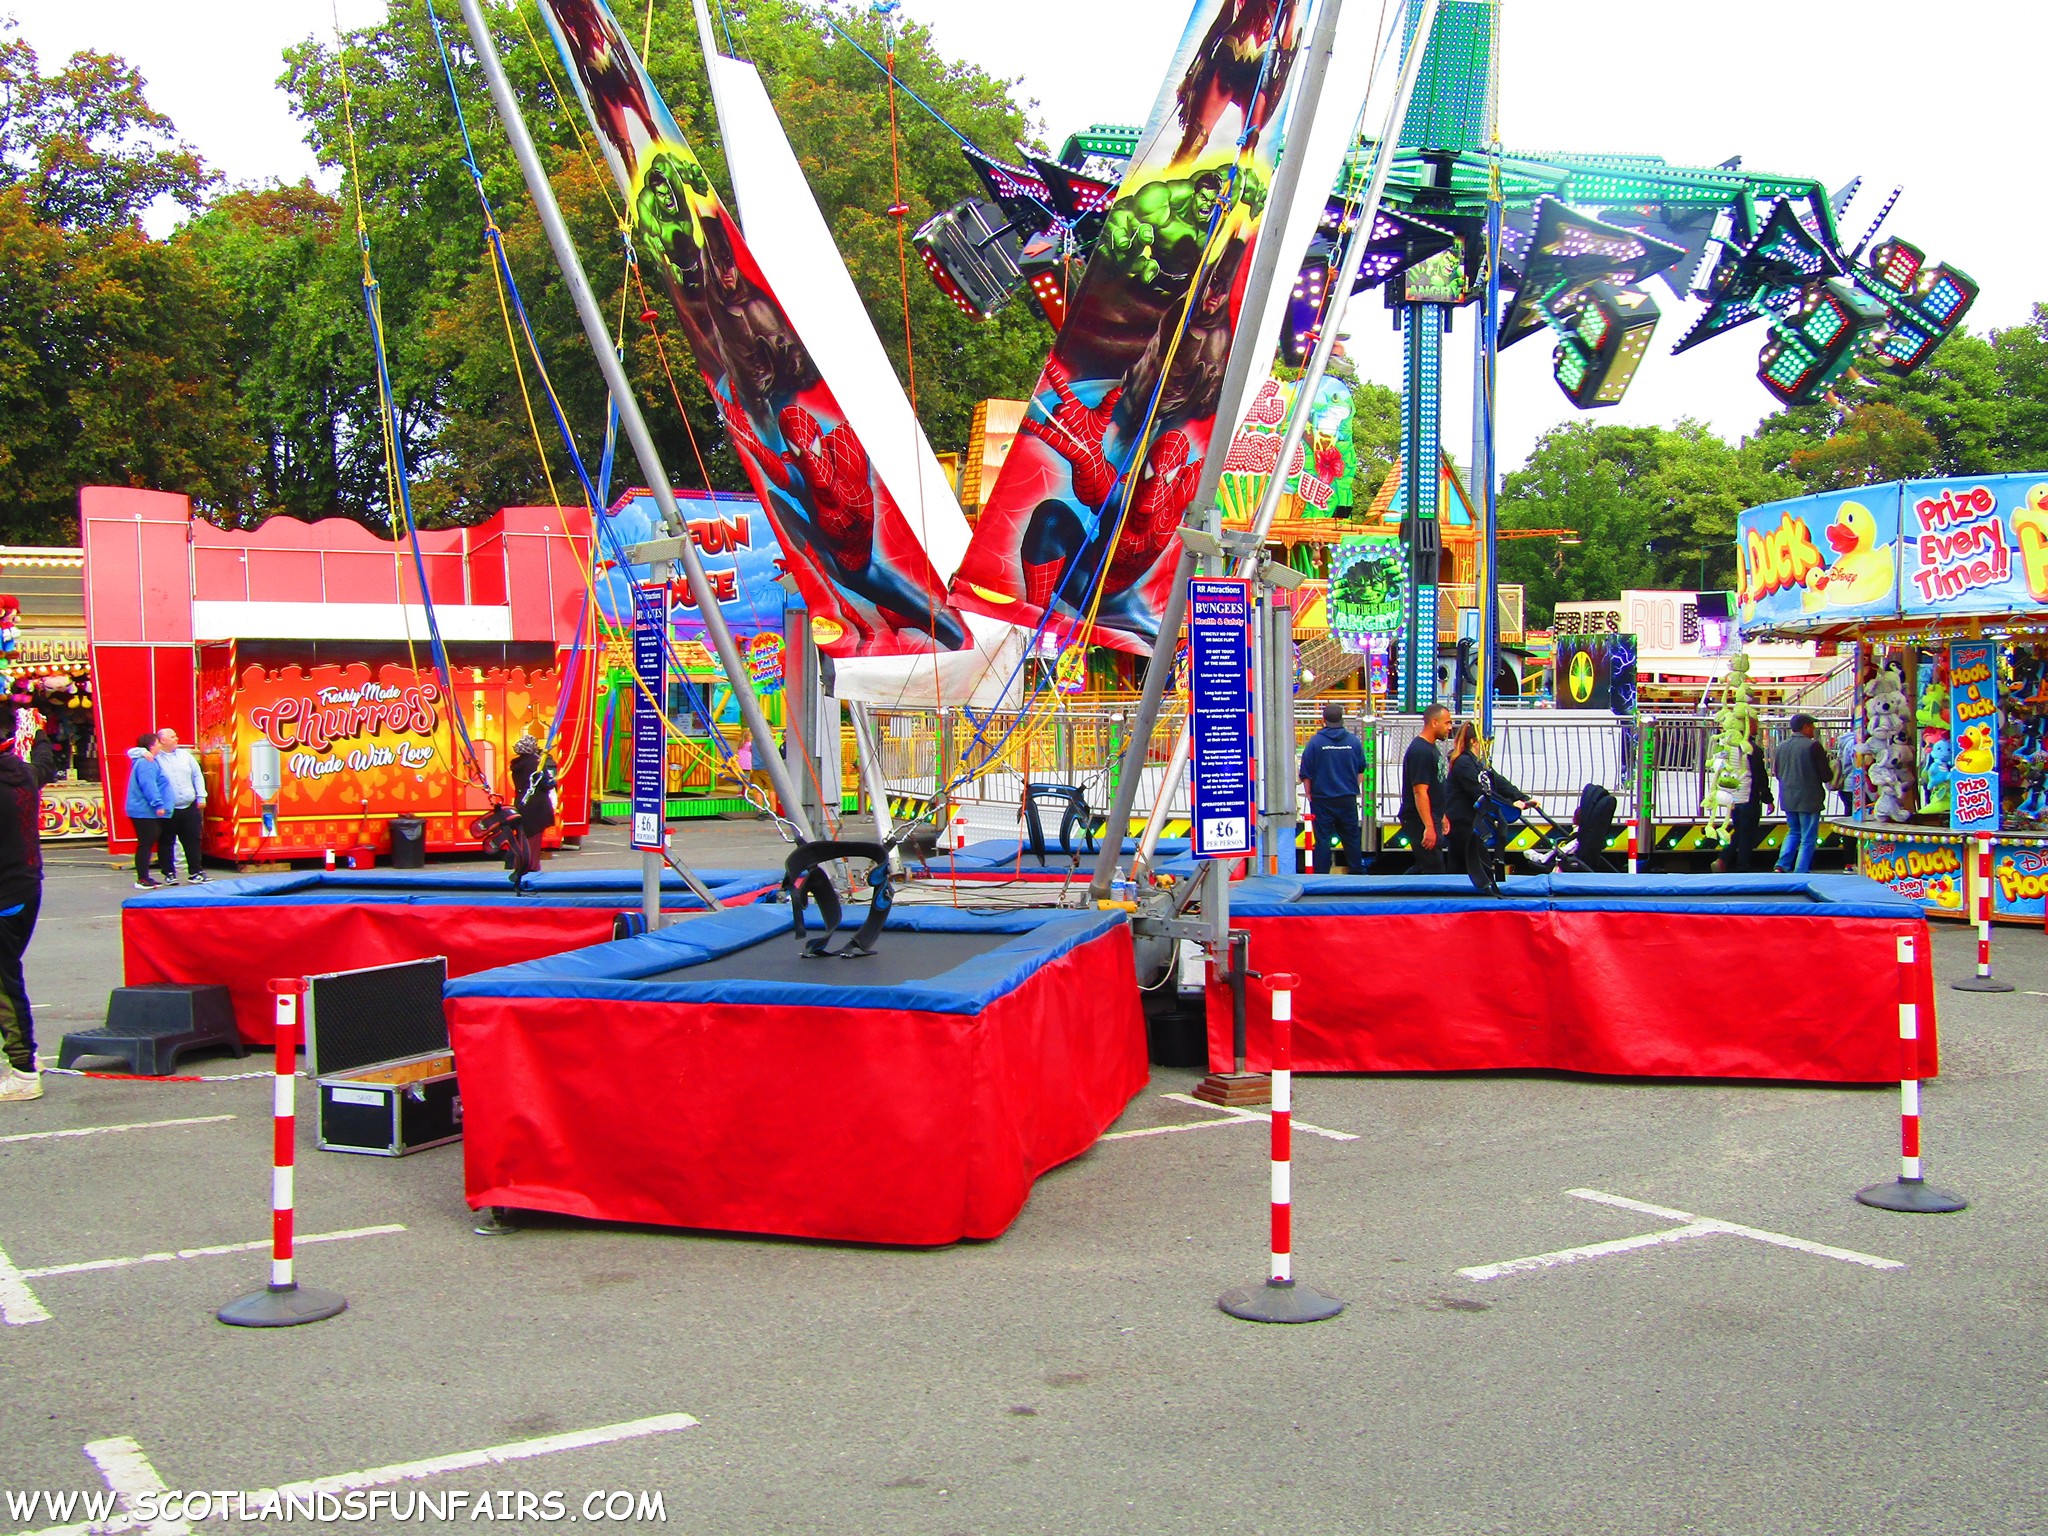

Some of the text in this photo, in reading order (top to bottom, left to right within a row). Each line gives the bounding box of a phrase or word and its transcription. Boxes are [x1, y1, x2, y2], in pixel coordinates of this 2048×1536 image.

[1410, 284, 1462, 298] ANGRY
[1300, 473, 1334, 509] UK
[1916, 488, 1992, 531] Prize
[1920, 518, 2000, 566] Every
[1914, 547, 2008, 601] Time!!
[1207, 586, 1240, 594] Attractions
[1196, 602, 1244, 614] BUNGEES
[1224, 618, 1244, 627] Safety
[1336, 610, 1400, 630] ANGRY
[1554, 611, 1621, 642] FRIES
[1632, 599, 1674, 650] BIG
[16, 640, 50, 662] THE
[754, 642, 779, 659] RIDE
[756, 654, 778, 671] THE
[752, 665, 782, 683] WAVE
[317, 682, 401, 707] Freshly Made
[1968, 684, 1980, 700] a
[1364, 727, 1376, 764] THE
[1643, 727, 1654, 765] THE
[290, 741, 434, 780] Made With Love
[1363, 768, 1375, 817] HULK
[1641, 768, 1652, 819] HULK
[1956, 778, 1986, 794] Prize
[1958, 791, 1990, 807] Every
[1956, 802, 1992, 821] Time!!
[642, 815, 651, 832] £6
[1216, 821, 1233, 837] £6
[1895, 856, 1908, 879] a
[1900, 880, 1923, 892] Every
